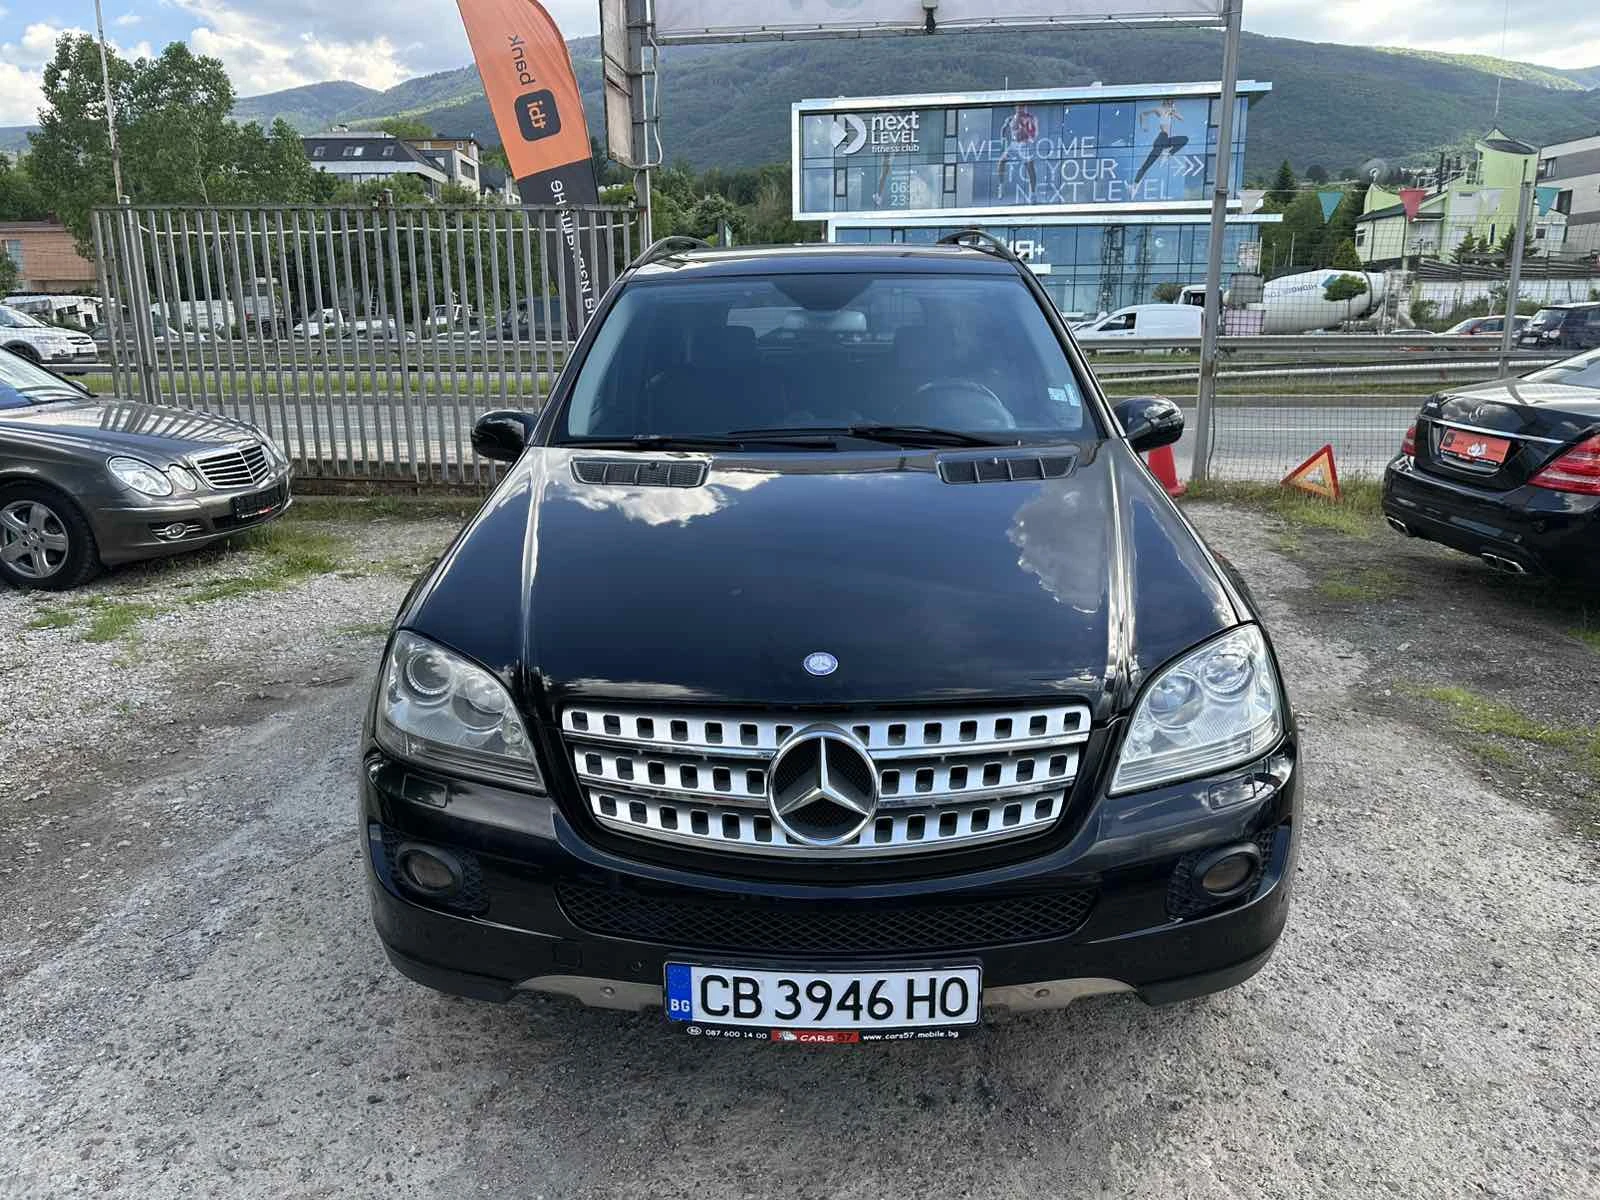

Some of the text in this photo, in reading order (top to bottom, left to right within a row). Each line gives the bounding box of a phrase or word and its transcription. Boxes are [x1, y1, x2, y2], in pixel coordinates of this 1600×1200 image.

[871, 111, 920, 131] next
[871, 130, 920, 144] LEVEL
[901, 143, 920, 152] club
[1046, 158, 1119, 181] YOUR
[1015, 178, 1176, 204] NEXT LEVEL
[671, 999, 690, 1012] BG
[701, 975, 969, 1021] CB 3946 HO
